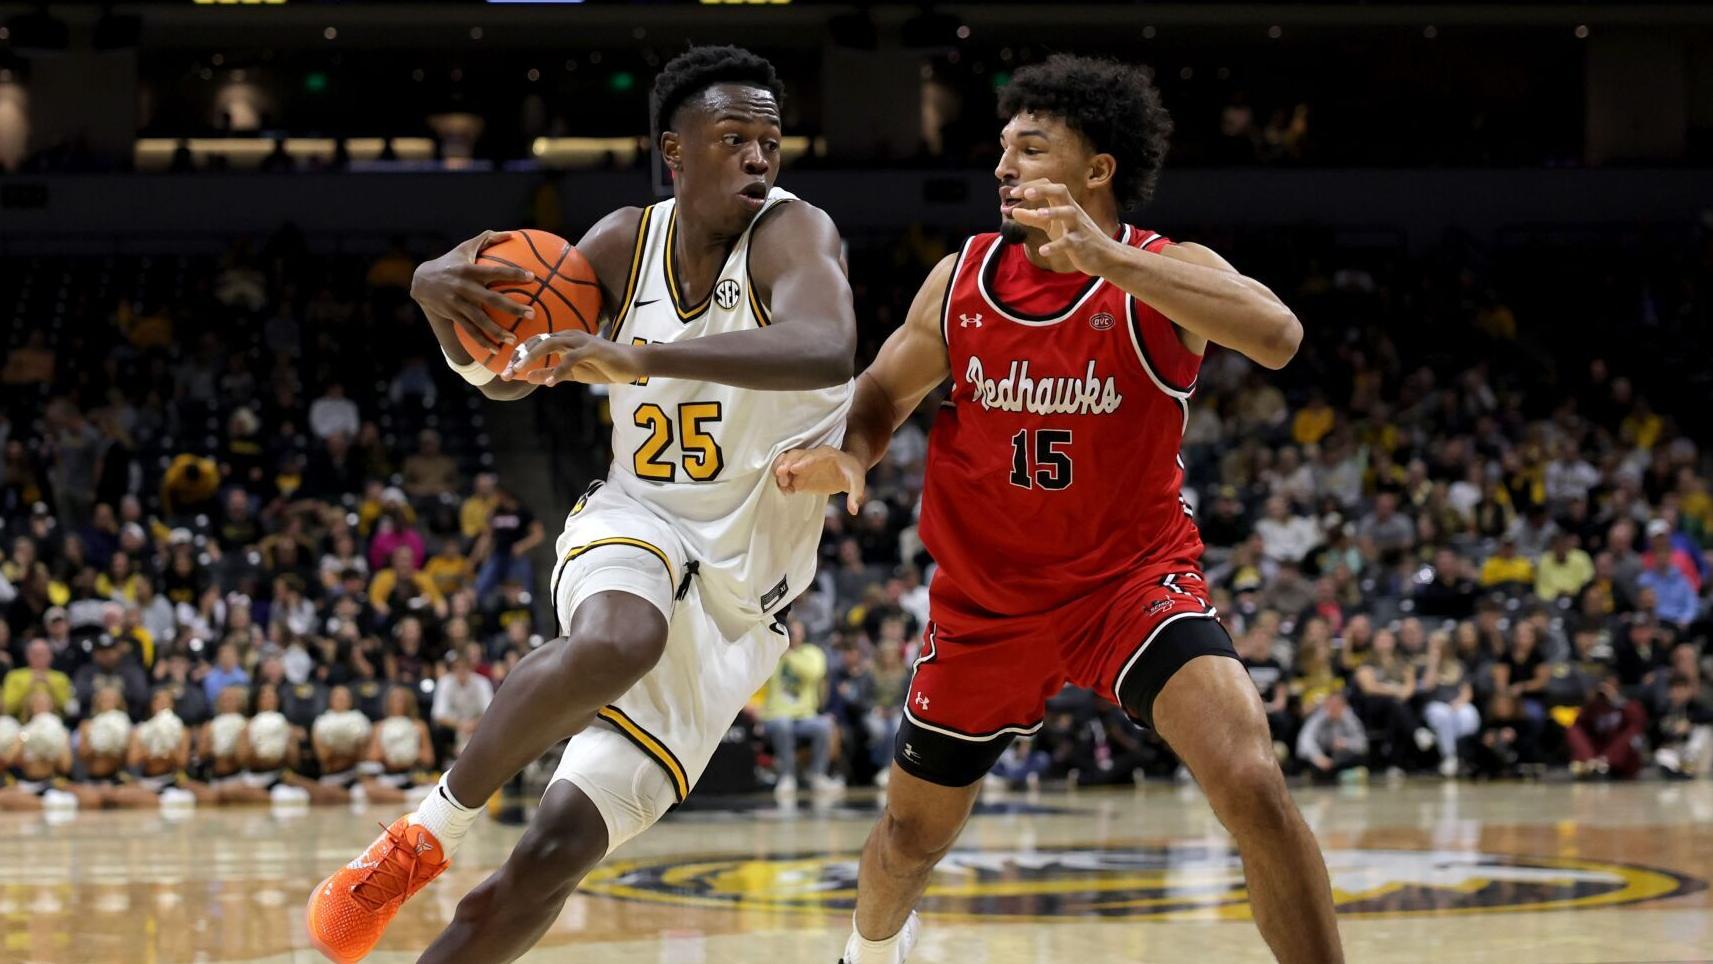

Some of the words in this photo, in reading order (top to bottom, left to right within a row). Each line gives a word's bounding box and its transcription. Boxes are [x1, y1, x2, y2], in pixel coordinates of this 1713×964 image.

[715, 280, 740, 309] SEC
[965, 356, 1123, 415] Redhawks
[633, 401, 724, 482] 25
[1010, 428, 1072, 490] 15
